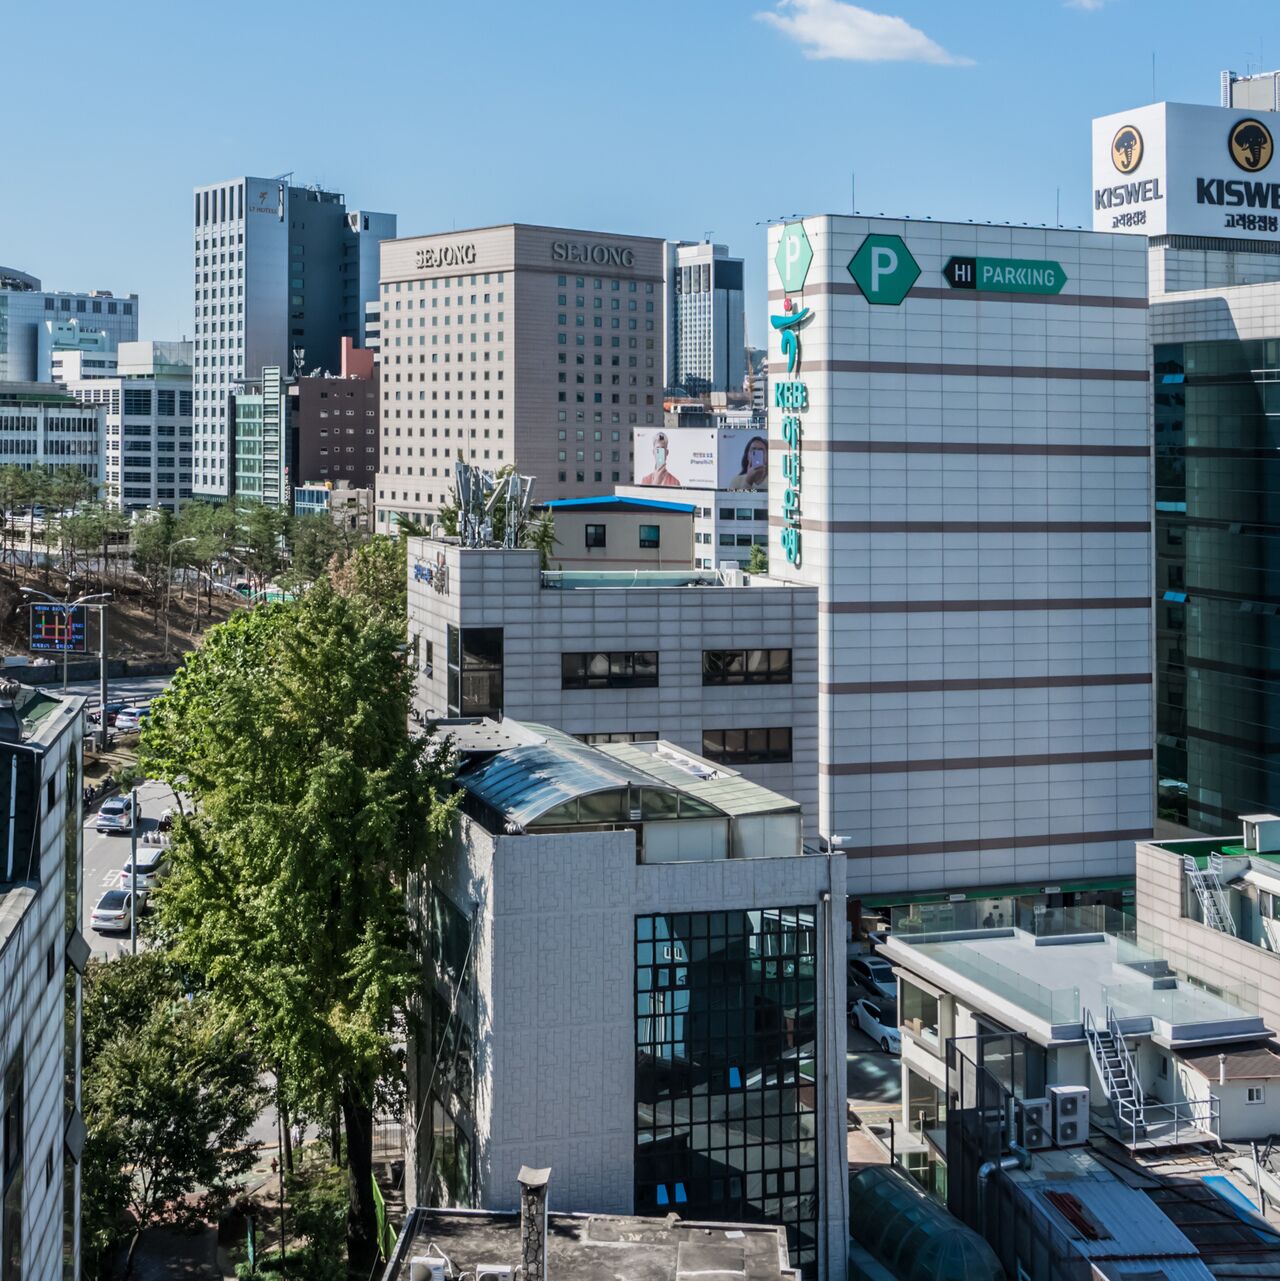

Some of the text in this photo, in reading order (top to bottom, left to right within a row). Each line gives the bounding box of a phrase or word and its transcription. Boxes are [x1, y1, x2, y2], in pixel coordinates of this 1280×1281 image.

[1094, 178, 1163, 210] KISWEL
[1111, 210, 1146, 228] 고려용접봉
[1224, 213, 1278, 232] 고려용접봉
[415, 242, 477, 269] SEJONG
[552, 241, 634, 267] SEJONG
[785, 234, 800, 281] P
[871, 246, 898, 292] P
[954, 264, 1055, 287] HI PARKING
[780, 416, 802, 565] 하나은행
